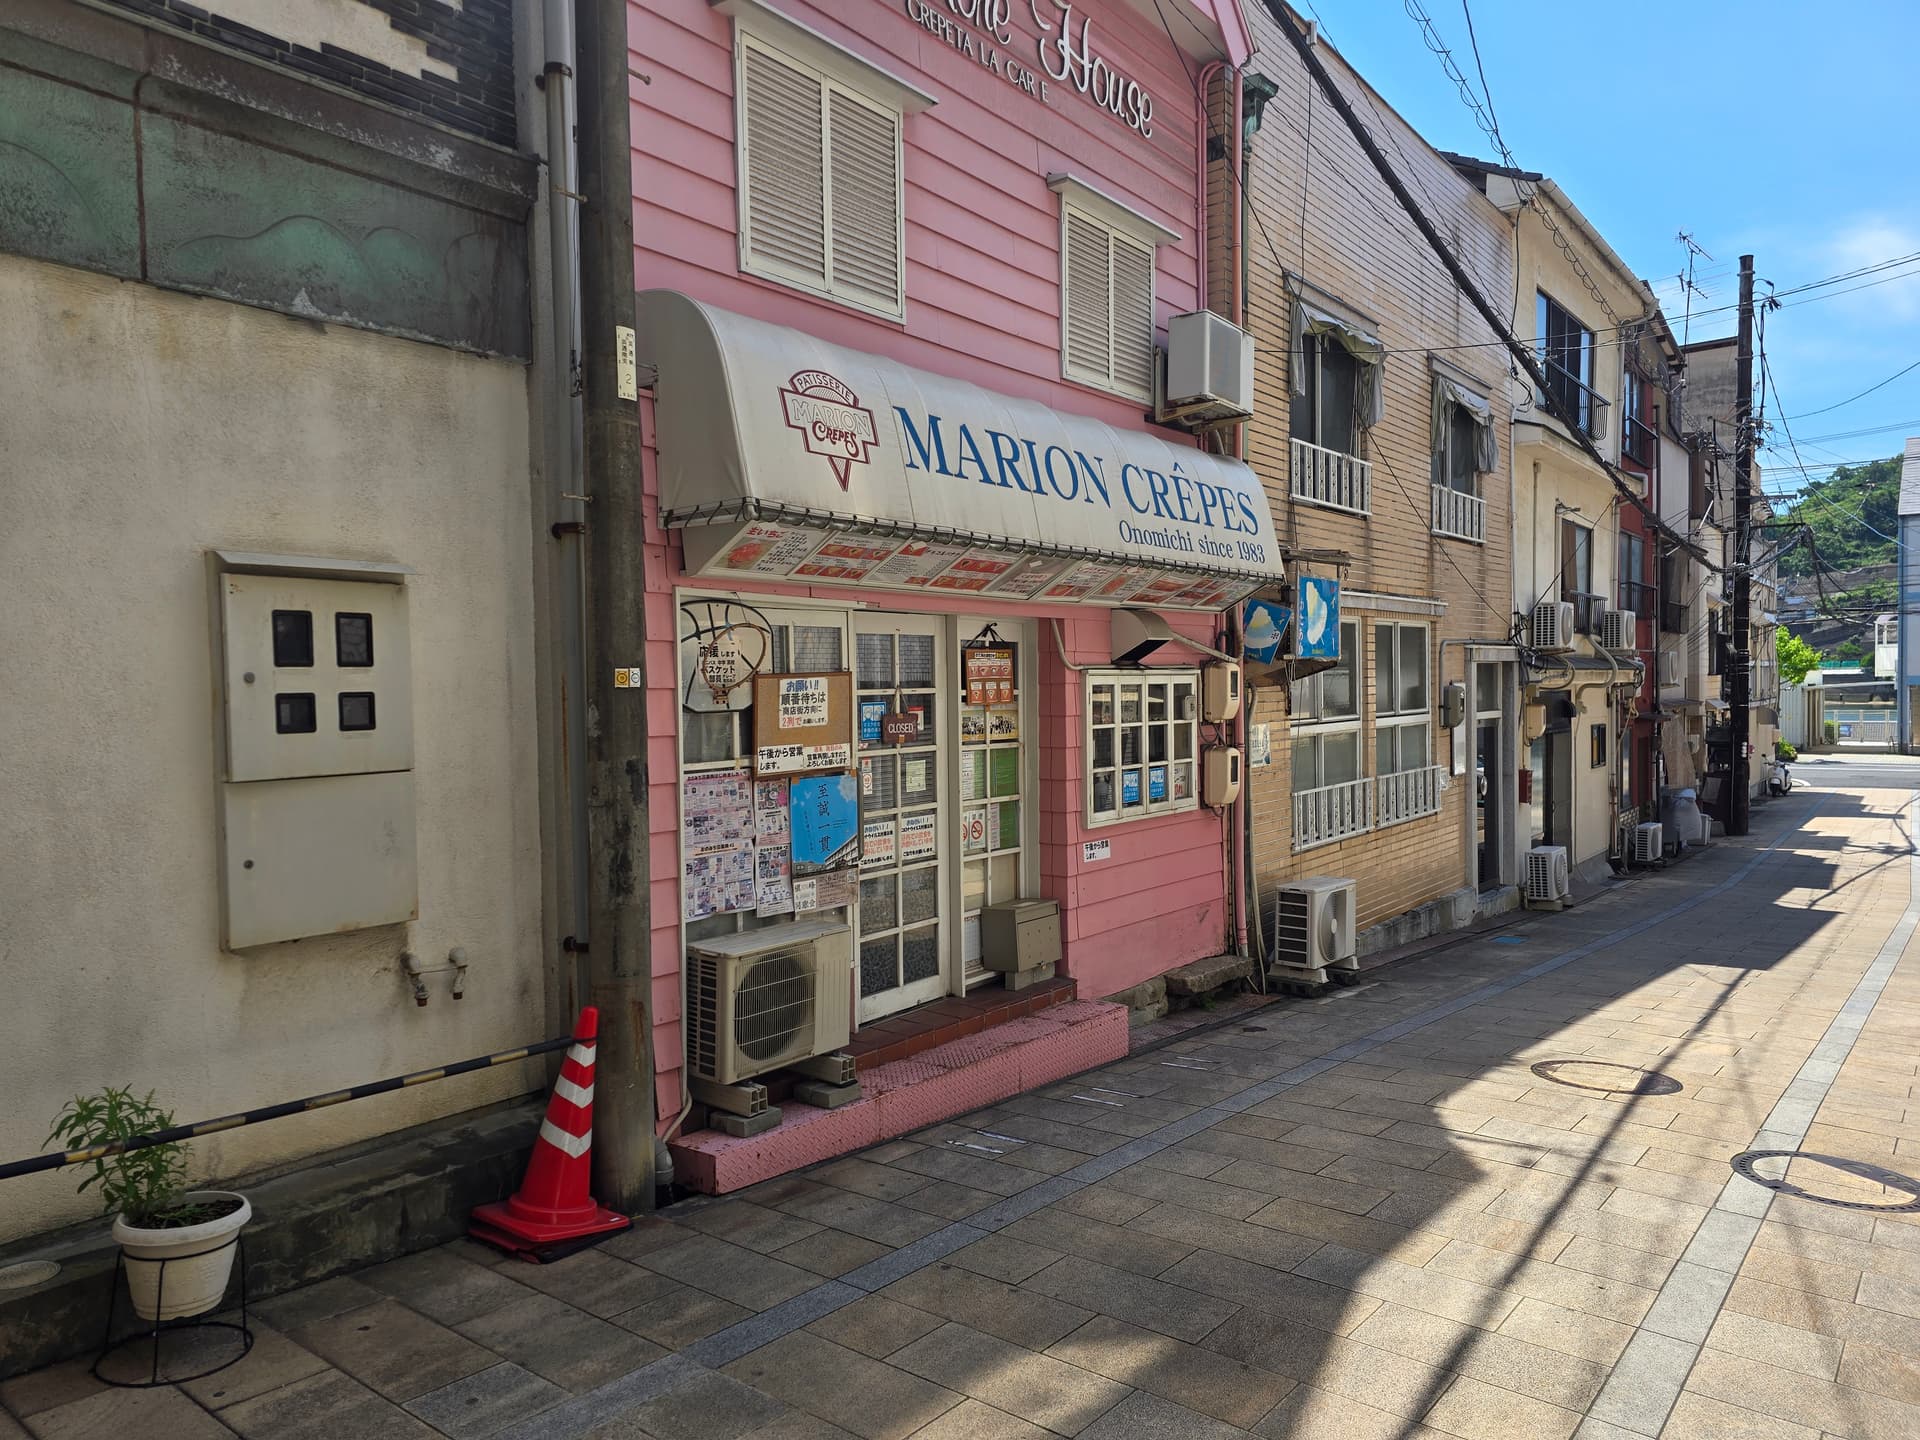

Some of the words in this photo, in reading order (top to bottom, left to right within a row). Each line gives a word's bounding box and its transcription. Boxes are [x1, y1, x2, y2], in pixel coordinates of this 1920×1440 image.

[980, 41, 999, 74] LA
[1031, 0, 1152, 139] House
[625, 373, 631, 385] 2
[797, 373, 851, 401] PATISSERIE
[792, 399, 871, 437] MARION
[812, 421, 859, 458] CREPES
[893, 405, 1111, 510] MARION
[1121, 462, 1259, 536] CRÊPES
[1119, 519, 1194, 552] Onomichi
[1198, 534, 1233, 559] since
[1237, 540, 1265, 564] 1983
[781, 691, 826, 705] 順番待ちは
[888, 723, 914, 734] CLOSED
[759, 746, 804, 760] 午後から営業
[760, 761, 780, 771] します。
